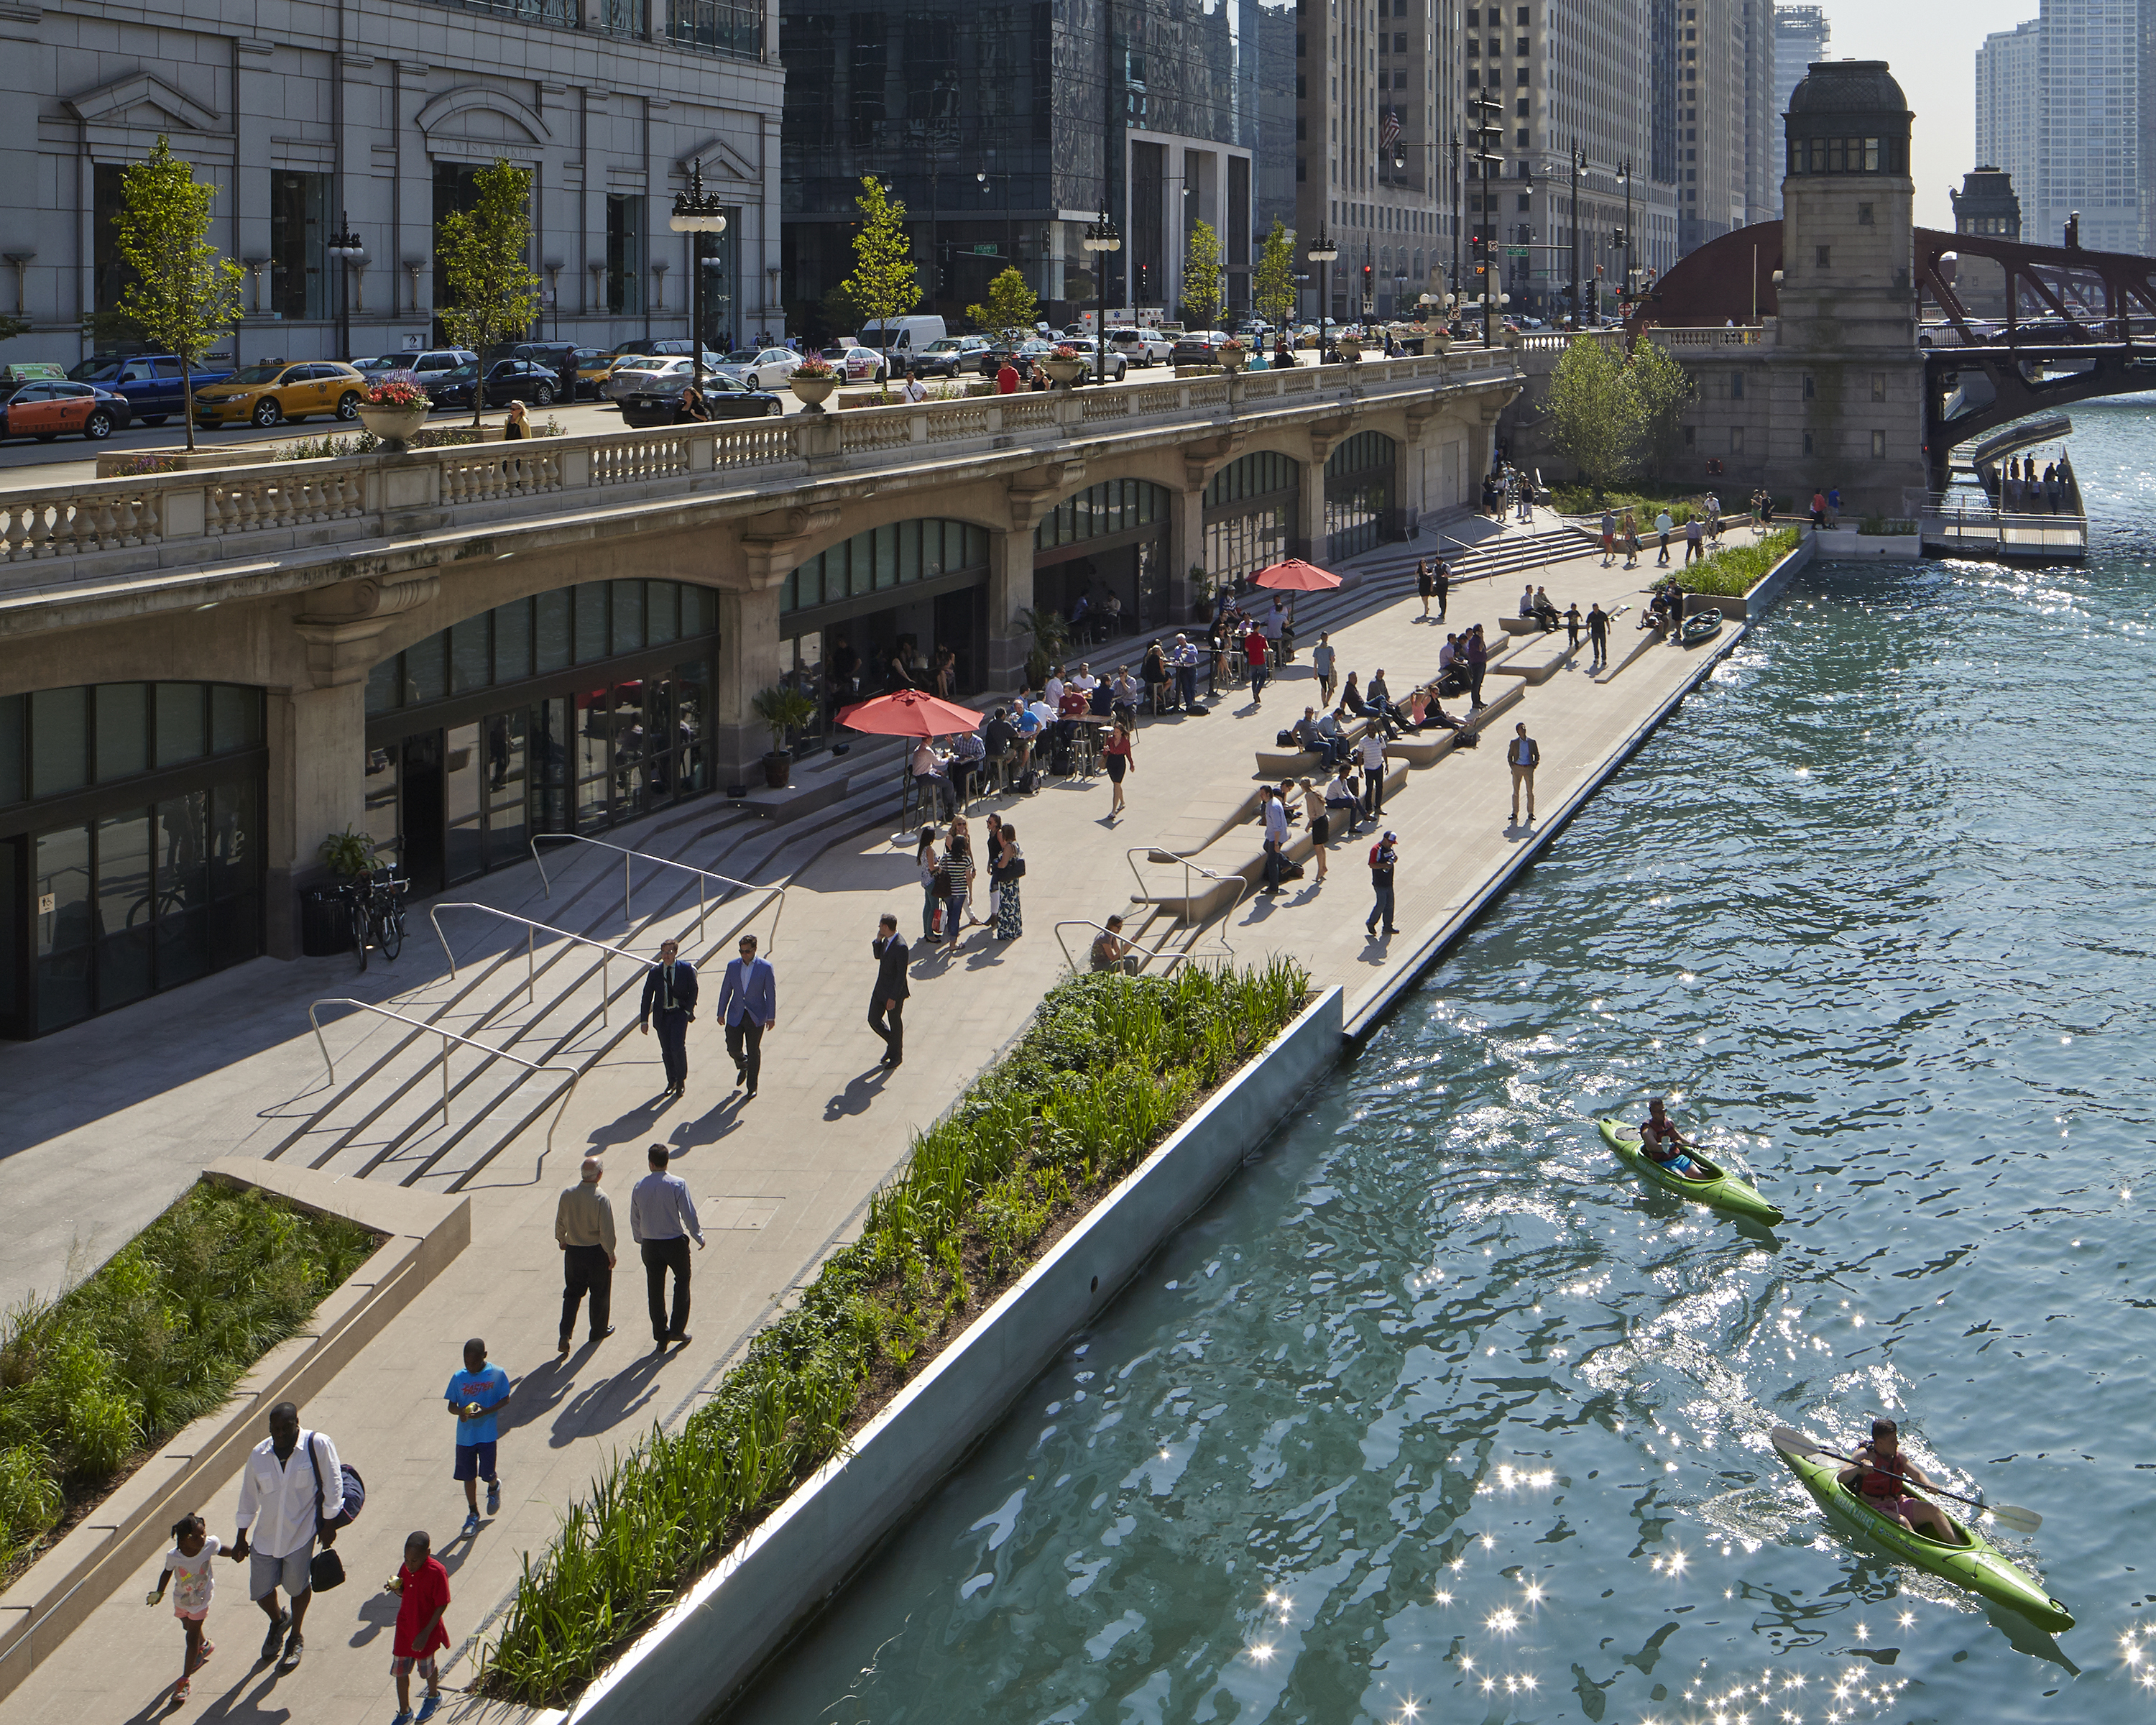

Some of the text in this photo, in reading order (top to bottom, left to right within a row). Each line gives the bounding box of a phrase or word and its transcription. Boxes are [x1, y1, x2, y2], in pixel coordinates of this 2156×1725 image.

[439, 139, 533, 160] 77 WEST WACKER
[1833, 1492, 1875, 1530] URBAN KAYAKS
